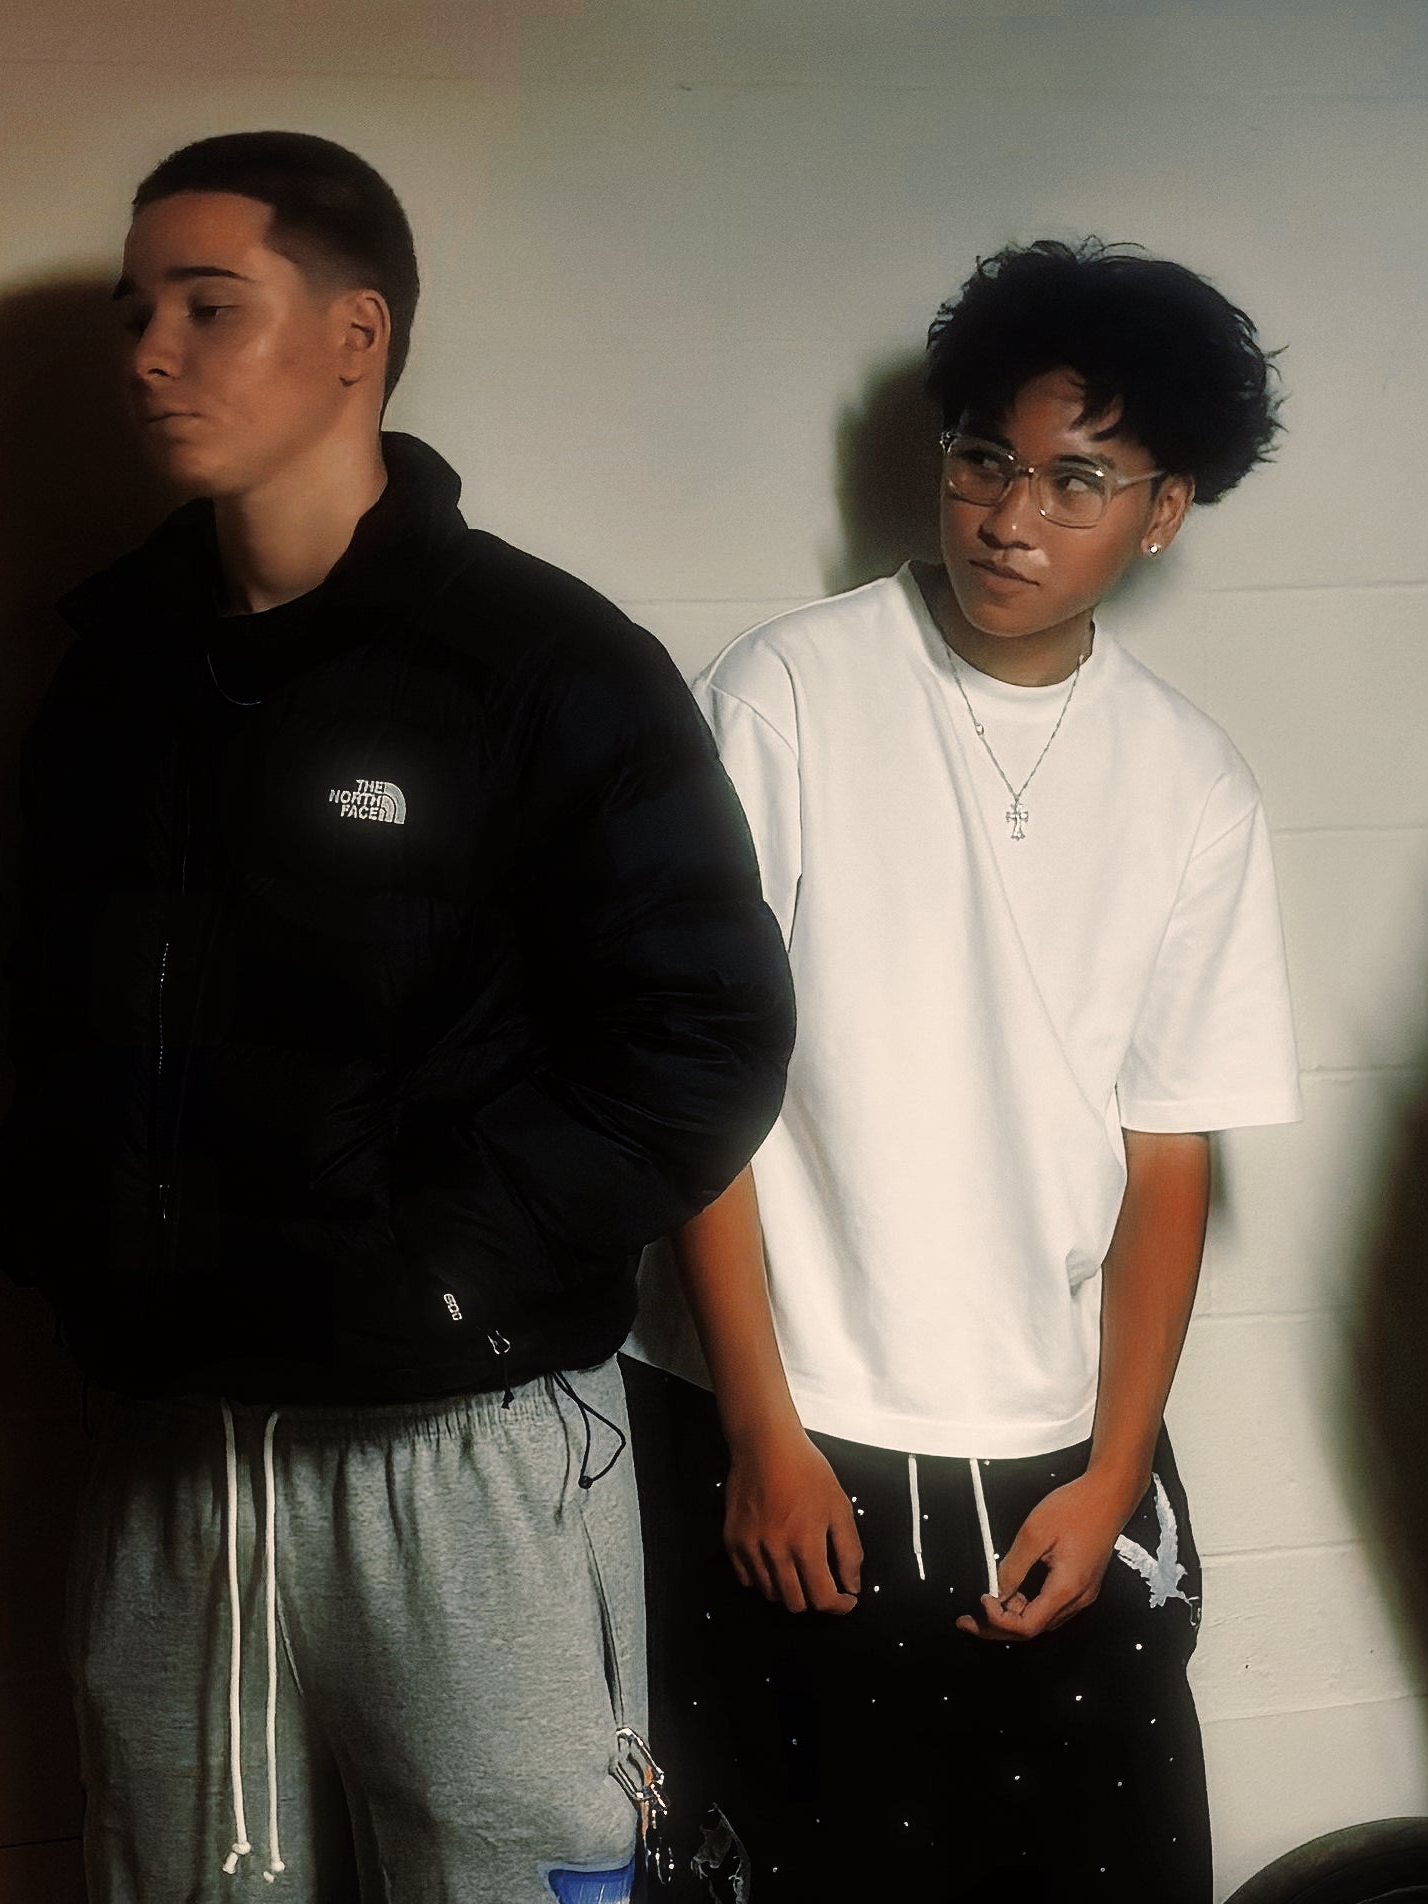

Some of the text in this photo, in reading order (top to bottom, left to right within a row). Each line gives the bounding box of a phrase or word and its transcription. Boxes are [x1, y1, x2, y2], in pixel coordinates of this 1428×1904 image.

[356, 779, 384, 794] THE
[328, 789, 383, 807] NORTH
[340, 804, 379, 820] FACE
